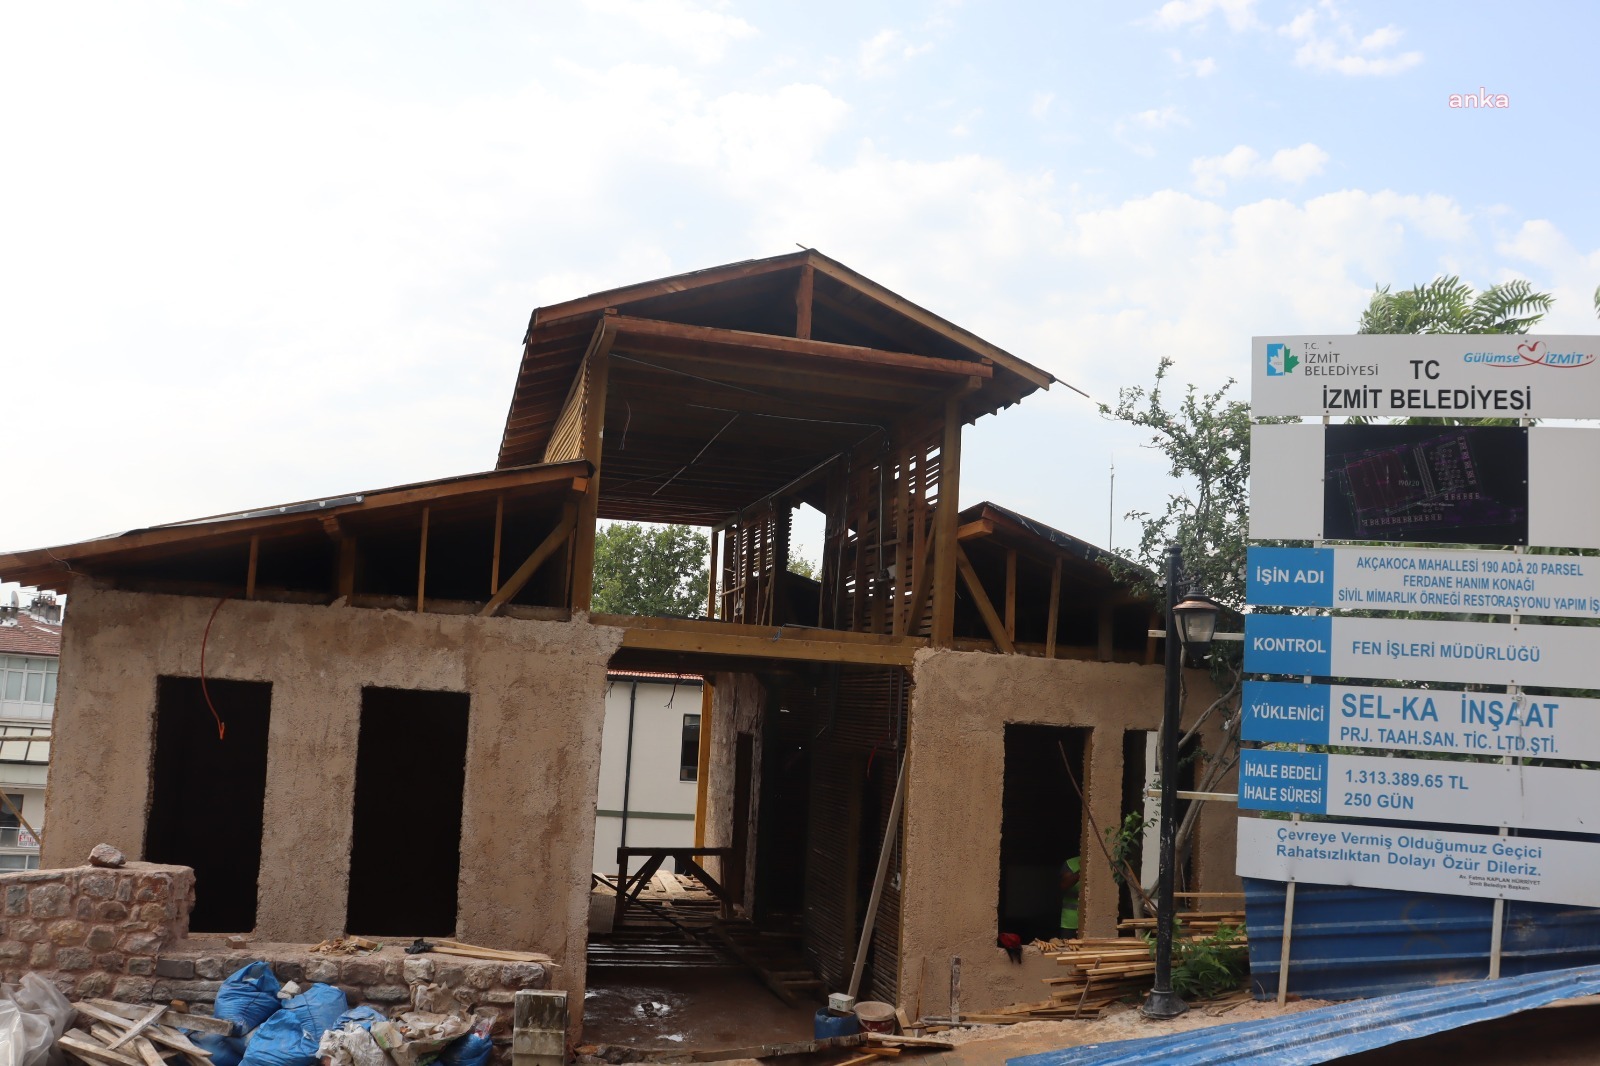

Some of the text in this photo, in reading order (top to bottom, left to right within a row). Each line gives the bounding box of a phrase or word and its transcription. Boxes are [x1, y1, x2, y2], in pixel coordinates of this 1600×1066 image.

[1304, 352, 1340, 363] İZMİT
[1464, 352, 1584, 364] Gülümse İZMİT
[1305, 364, 1378, 376] BELEDİYESİ
[1410, 360, 1440, 380] TC
[1323, 385, 1531, 410] İZMİT BELEDİYESİ
[1256, 566, 1324, 585] İŞİN ADI
[1357, 557, 1584, 576] AKÇAKOCA MAHALLESİ 190 ADA 20 PARSEL
[1404, 575, 1534, 591] FERDANE HANIM KONAĞI
[1338, 587, 1363, 602] SİVİL
[1366, 588, 1416, 604] MİMARLIK
[1420, 590, 1460, 606] ÖRNEĞİ
[1464, 594, 1550, 609] RESTORASYONU
[1554, 598, 1586, 610] YAPIM
[1254, 638, 1326, 653] KONTROL
[1352, 640, 1540, 662] FEN İŞLERİ MÜDÜRLÜĞÜ
[1252, 703, 1324, 722] YÜKLENİCİ
[1342, 693, 1558, 732] SEL-KA İNŞAAT
[1340, 727, 1372, 742] PRJ.
[1464, 731, 1492, 749] TİC.
[1246, 760, 1321, 781] İHALE BEDELİ
[1346, 770, 1468, 790] 1.313.389.65 TL
[1244, 783, 1321, 804] İHALE SÜRESİ
[1344, 792, 1414, 810] 250 GÜN
[1277, 828, 1542, 859] Çevreye Vermiş Olduğumuz Geçici
[1276, 845, 1541, 876] Rahatsızlıktan Dolayı Özür Dileriz.
